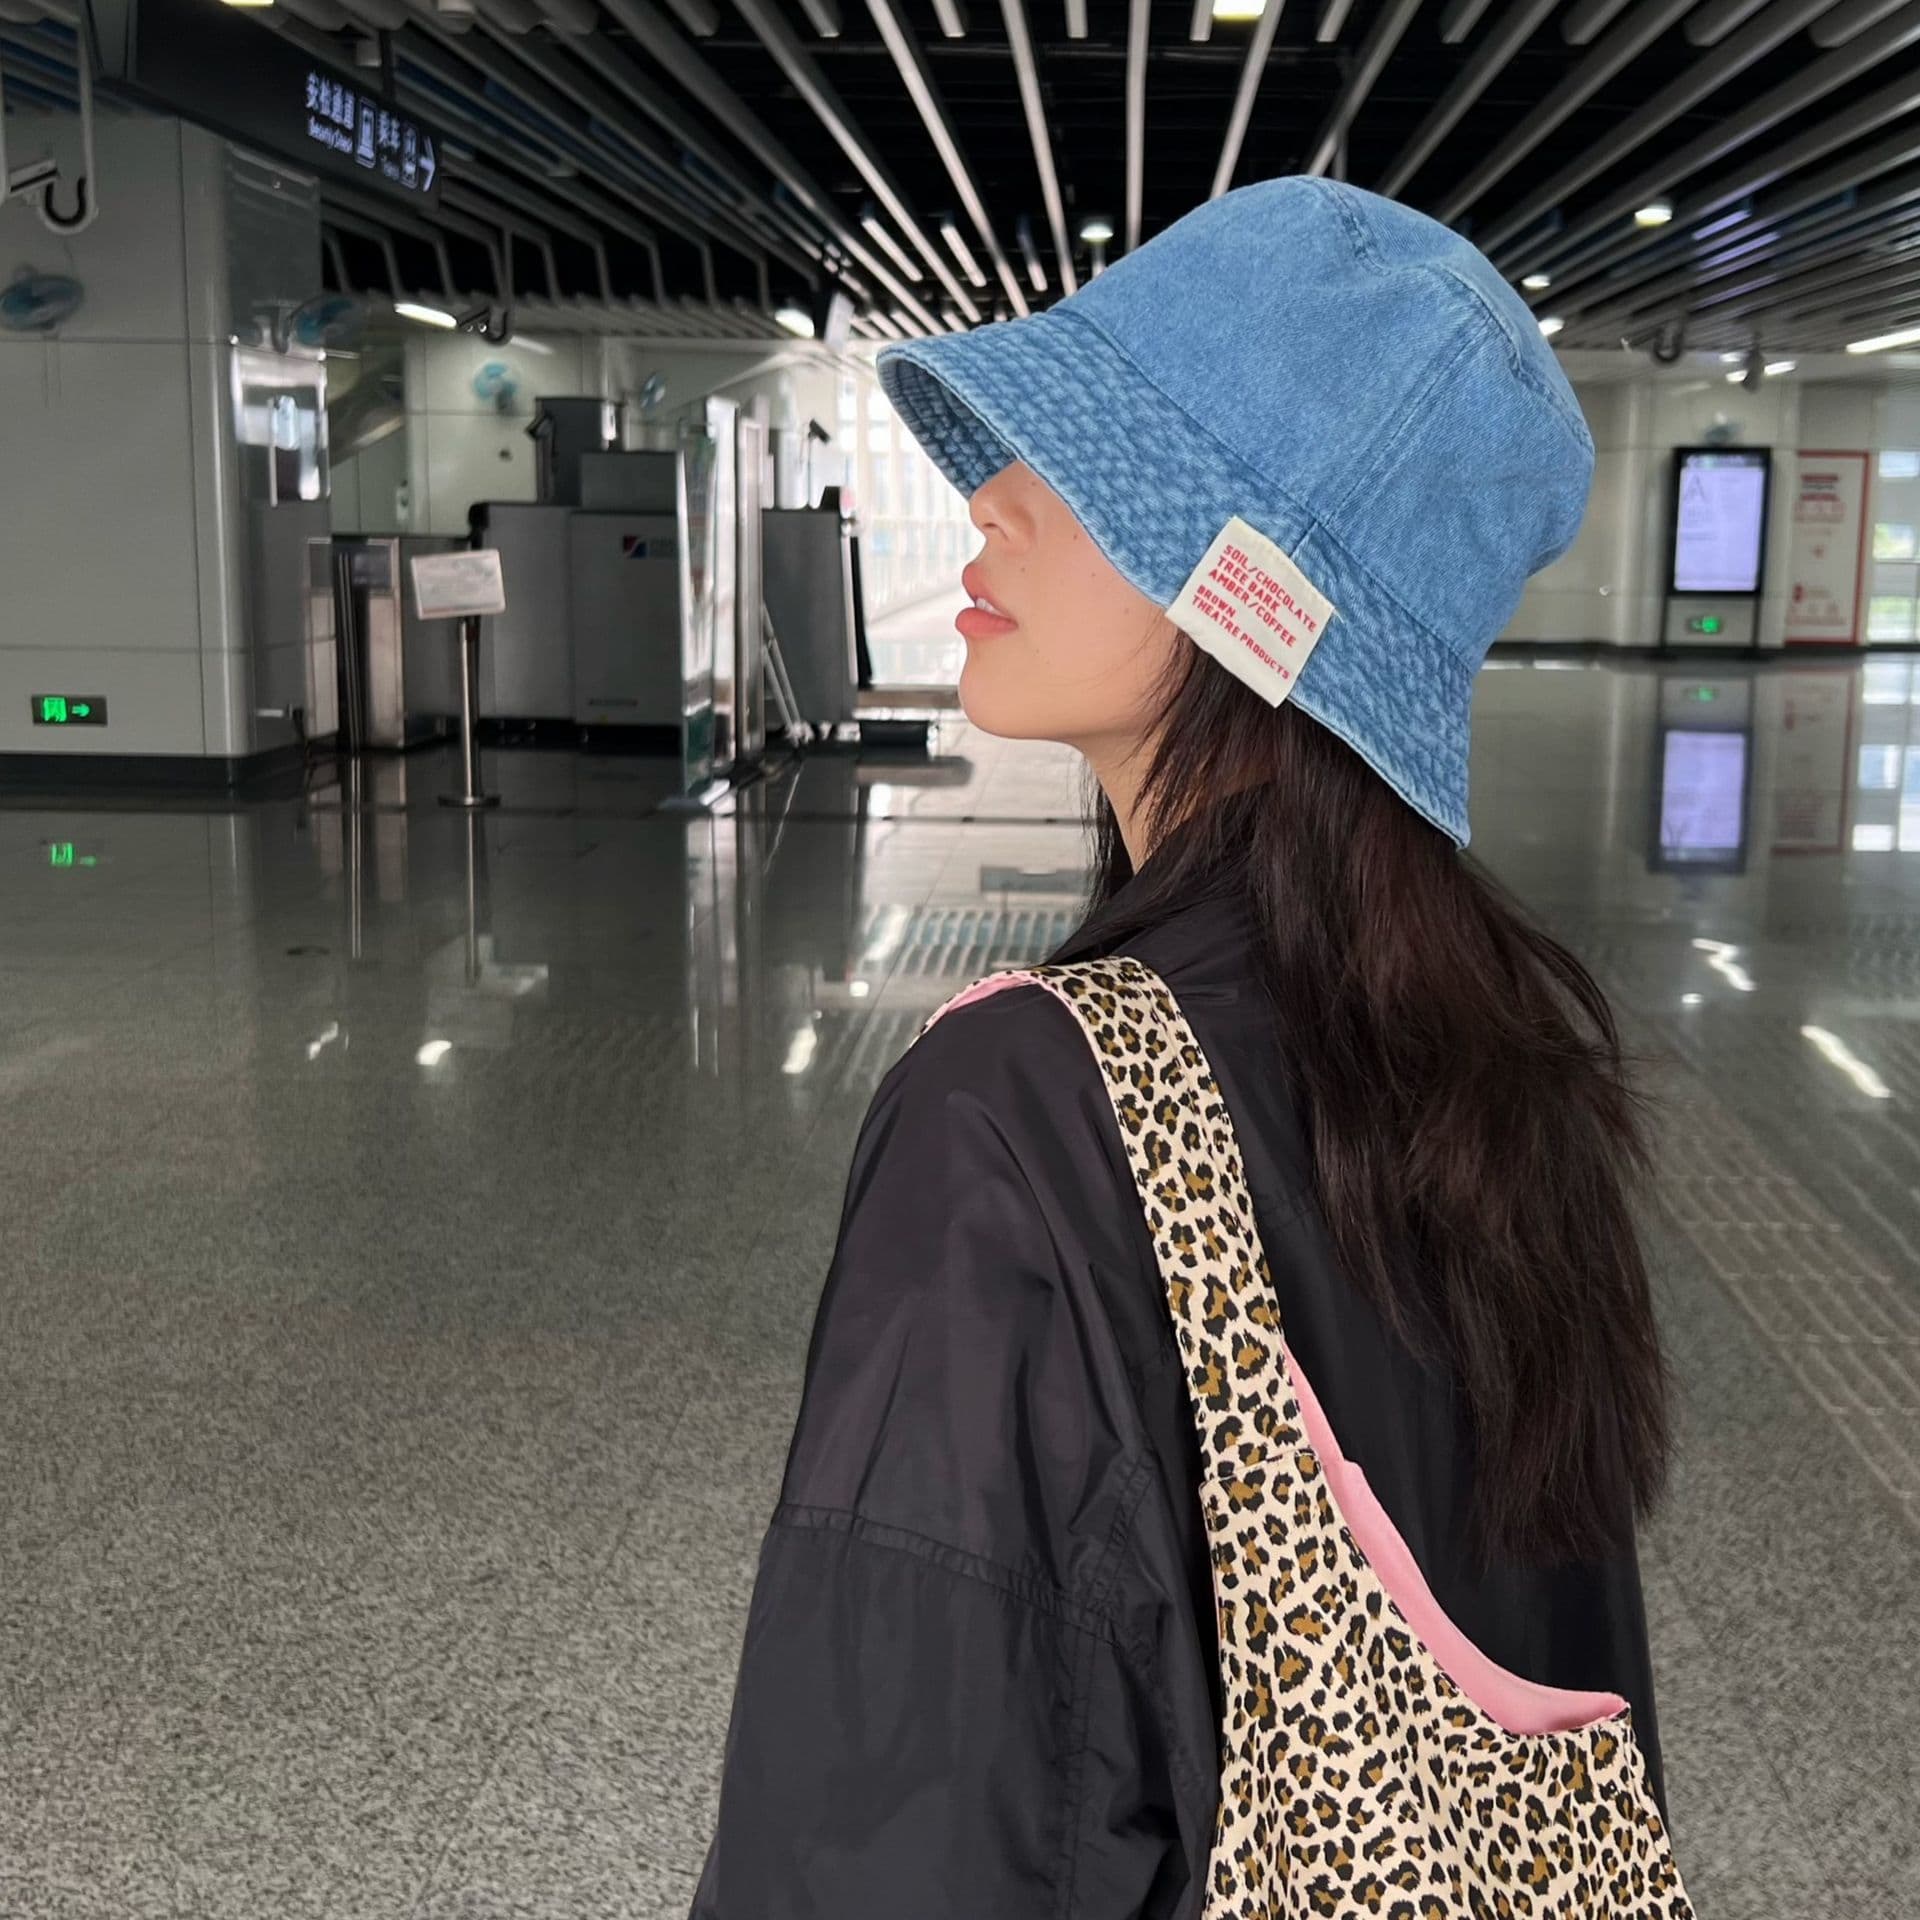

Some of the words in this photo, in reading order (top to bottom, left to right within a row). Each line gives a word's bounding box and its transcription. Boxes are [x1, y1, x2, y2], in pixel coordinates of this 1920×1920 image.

[1196, 584, 1236, 618] BROWN
[1208, 568, 1297, 648] AMBER/COFFEE
[1217, 556, 1247, 584] TREE
[1248, 580, 1281, 613] BARK
[1223, 544, 1317, 633] SOIL/CHOCOLATE
[1191, 595, 1241, 636] THEATRE
[1240, 632, 1290, 680] PRODUCTS
